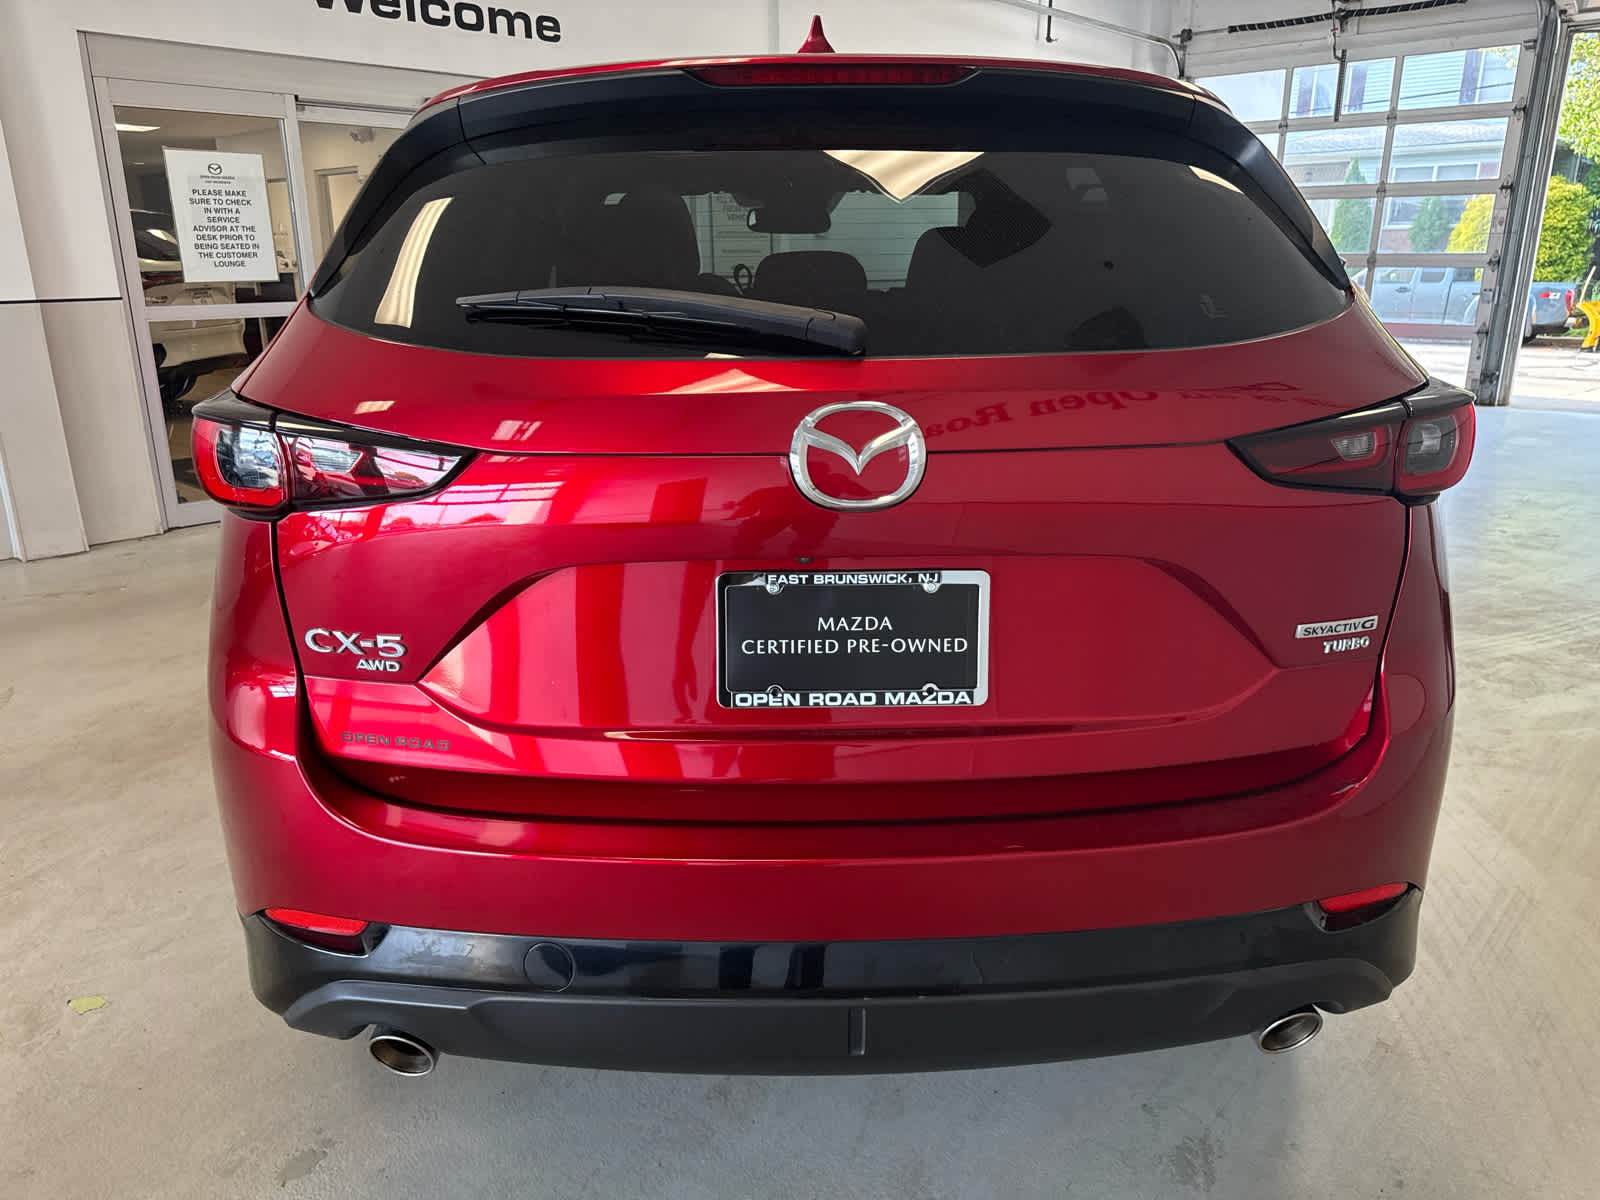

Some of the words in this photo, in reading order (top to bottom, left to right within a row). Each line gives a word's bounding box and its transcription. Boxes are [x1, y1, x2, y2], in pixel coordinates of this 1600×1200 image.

[192, 189, 222, 197] PLEASE
[225, 190, 247, 198] MAKE
[213, 198, 224, 206] TO
[206, 216, 240, 224] SERVICE
[193, 225, 228, 233] ADVISOR
[229, 225, 239, 233] AT
[241, 225, 256, 233] THE
[199, 251, 214, 259] THE
[215, 251, 258, 259] CUSTOMER
[214, 260, 246, 268] LOUNGE
[767, 574, 809, 585] EAST
[813, 573, 913, 585] BRUNSWICK,
[918, 573, 939, 583] NJ
[817, 616, 893, 631] MAZDA
[304, 628, 407, 658] CX-5
[741, 639, 839, 655] CERTIFIED
[847, 638, 968, 653] PRE-OWNED
[1323, 635, 1370, 654] TURBO
[356, 658, 401, 672] AWD
[735, 693, 800, 706] OPEN
[808, 692, 877, 706] ROAD
[885, 691, 972, 705] MAZDA
[341, 731, 391, 745] OPEN
[396, 736, 450, 751] ROAD
